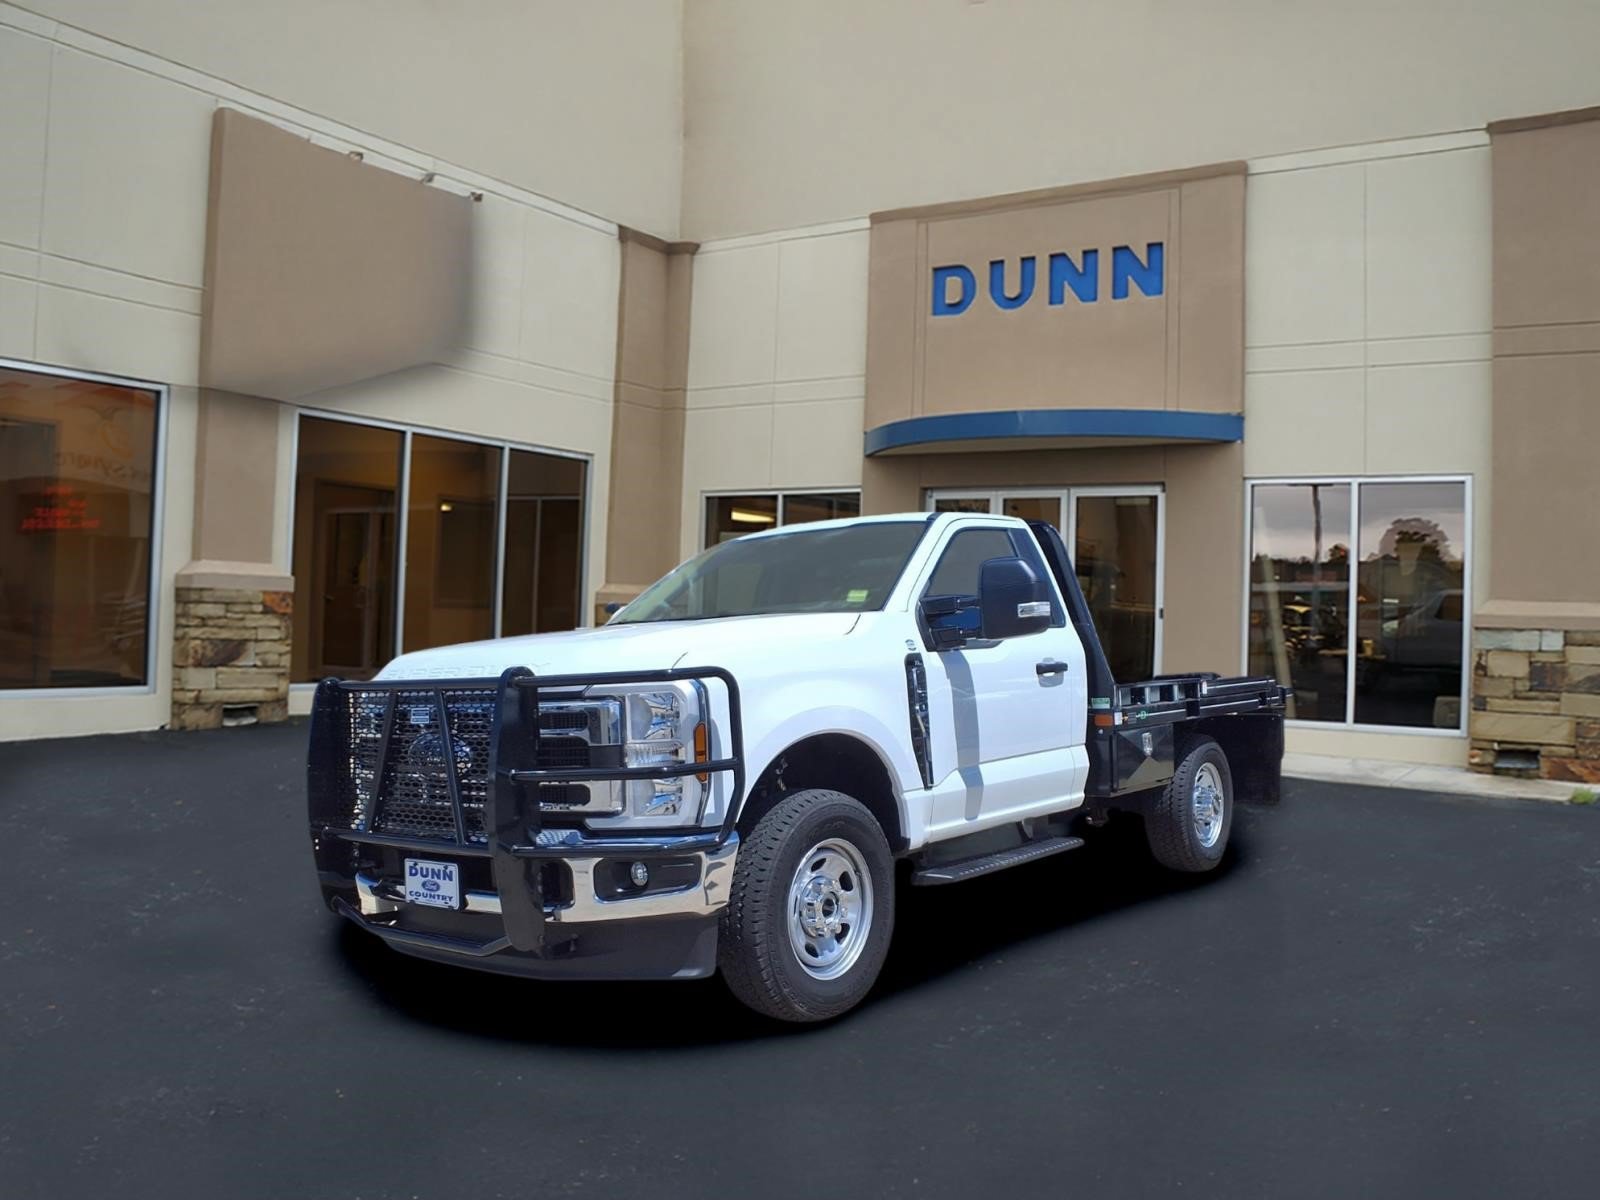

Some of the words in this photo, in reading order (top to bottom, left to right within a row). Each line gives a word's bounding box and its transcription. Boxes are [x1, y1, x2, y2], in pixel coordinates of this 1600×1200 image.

[931, 241, 1164, 316] DUNN
[408, 865, 453, 881] DUNN
[408, 890, 453, 902] COUNTRY
